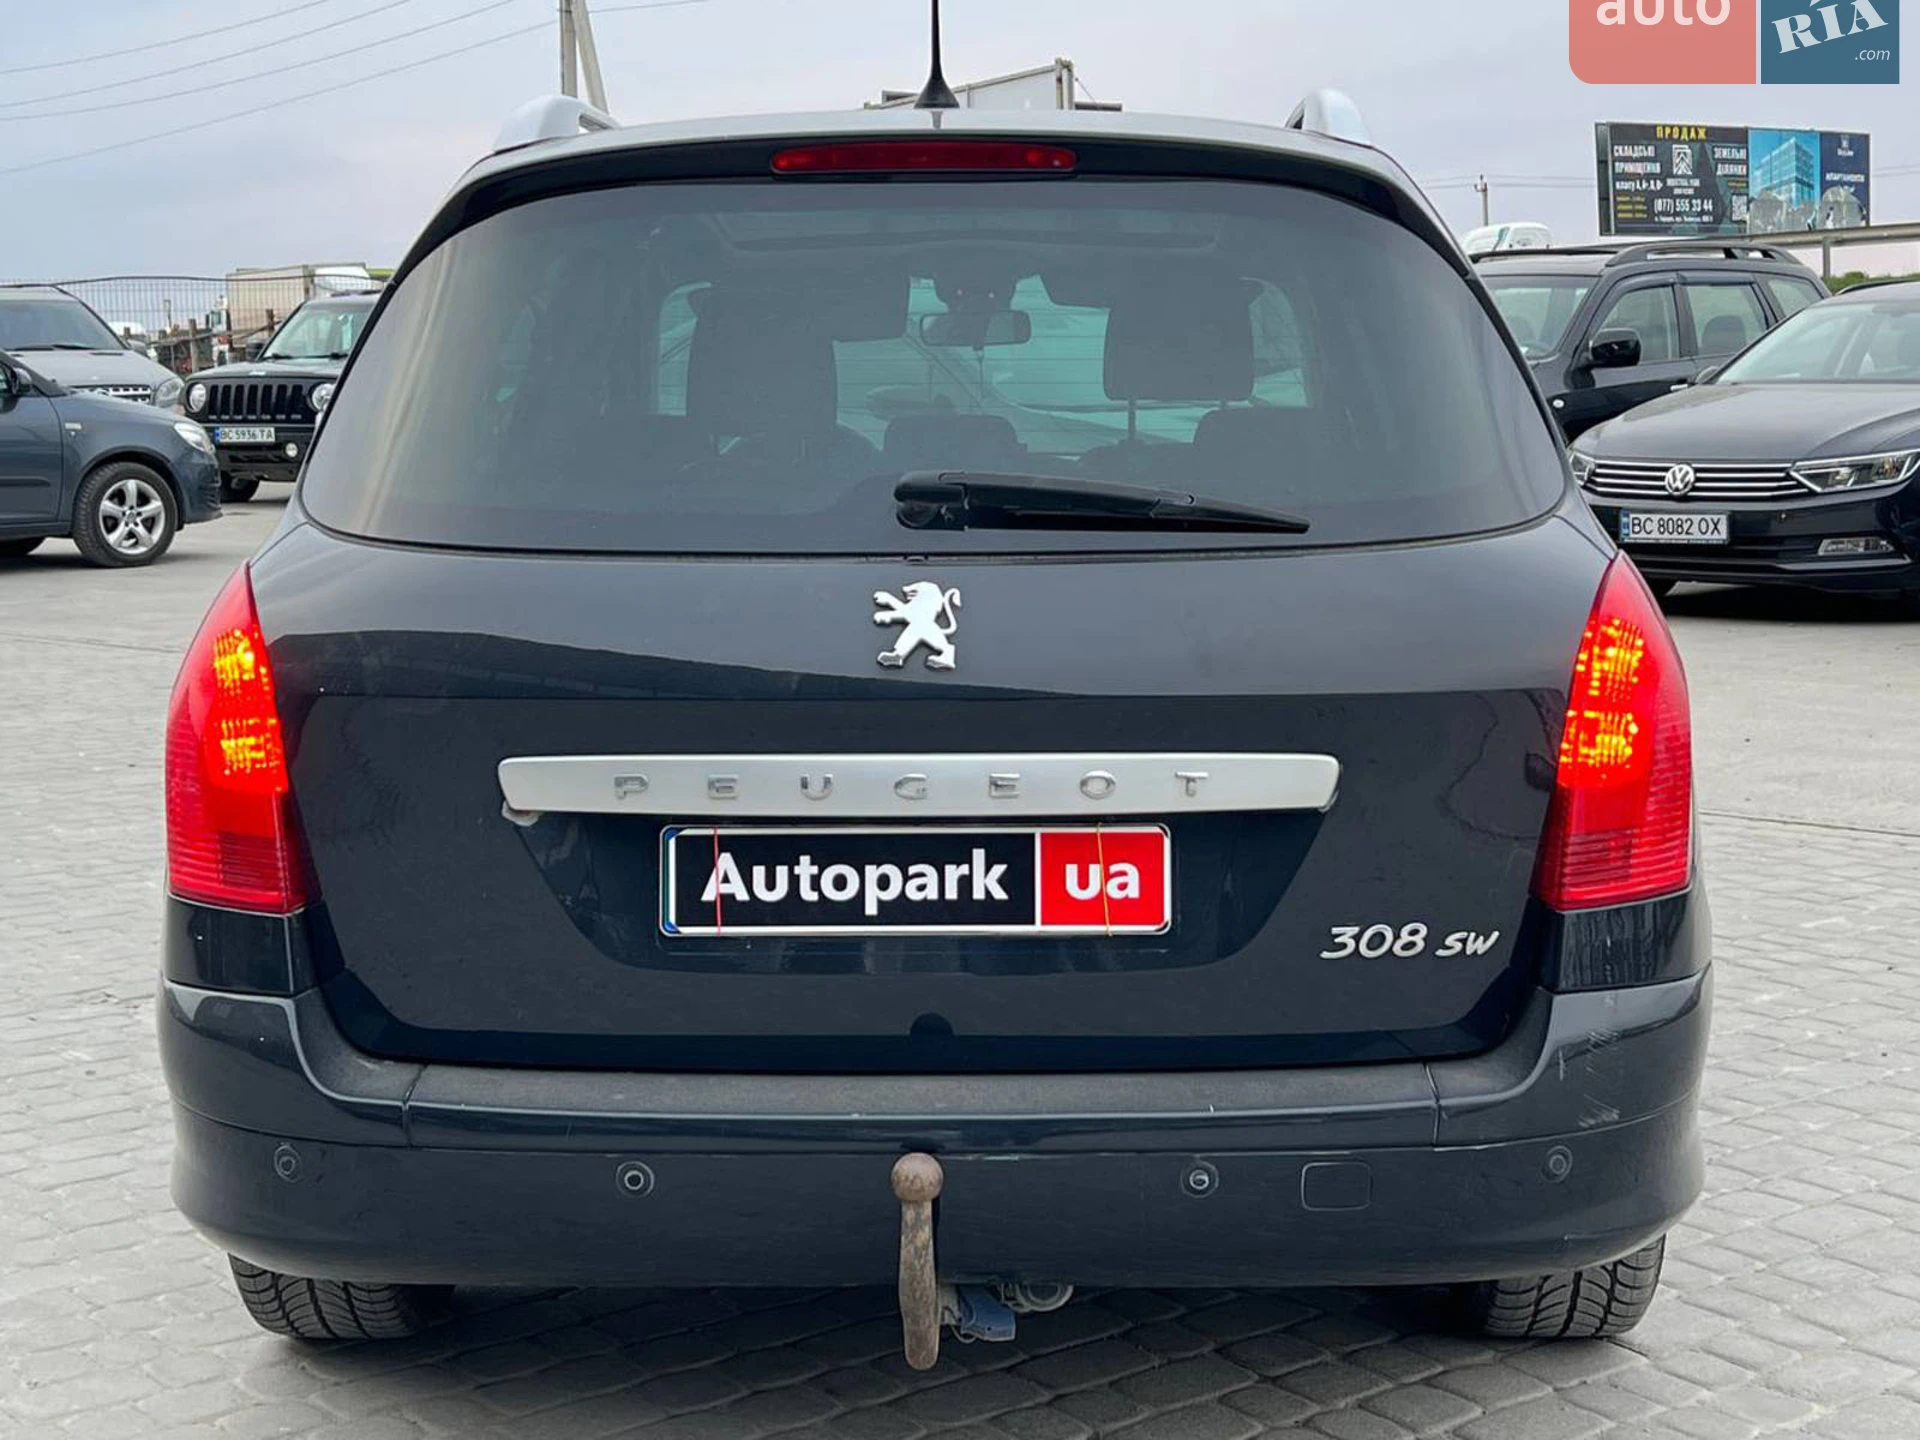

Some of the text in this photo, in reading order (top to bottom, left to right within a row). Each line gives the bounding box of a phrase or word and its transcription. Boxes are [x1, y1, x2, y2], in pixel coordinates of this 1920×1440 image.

[1656, 125, 1706, 141] ПРОДАЖ
[1654, 198, 1674, 214] (077)
[1675, 198, 1690, 212] 555
[1691, 198, 1701, 212] 33
[1702, 198, 1713, 212] 44
[235, 429, 257, 440] 5936
[259, 429, 273, 440] TA
[1631, 516, 1721, 535] BC 8082 OX
[614, 771, 1209, 800] PEUGEOT
[700, 848, 1141, 916] Autopark ua
[1319, 922, 1428, 959] 308
